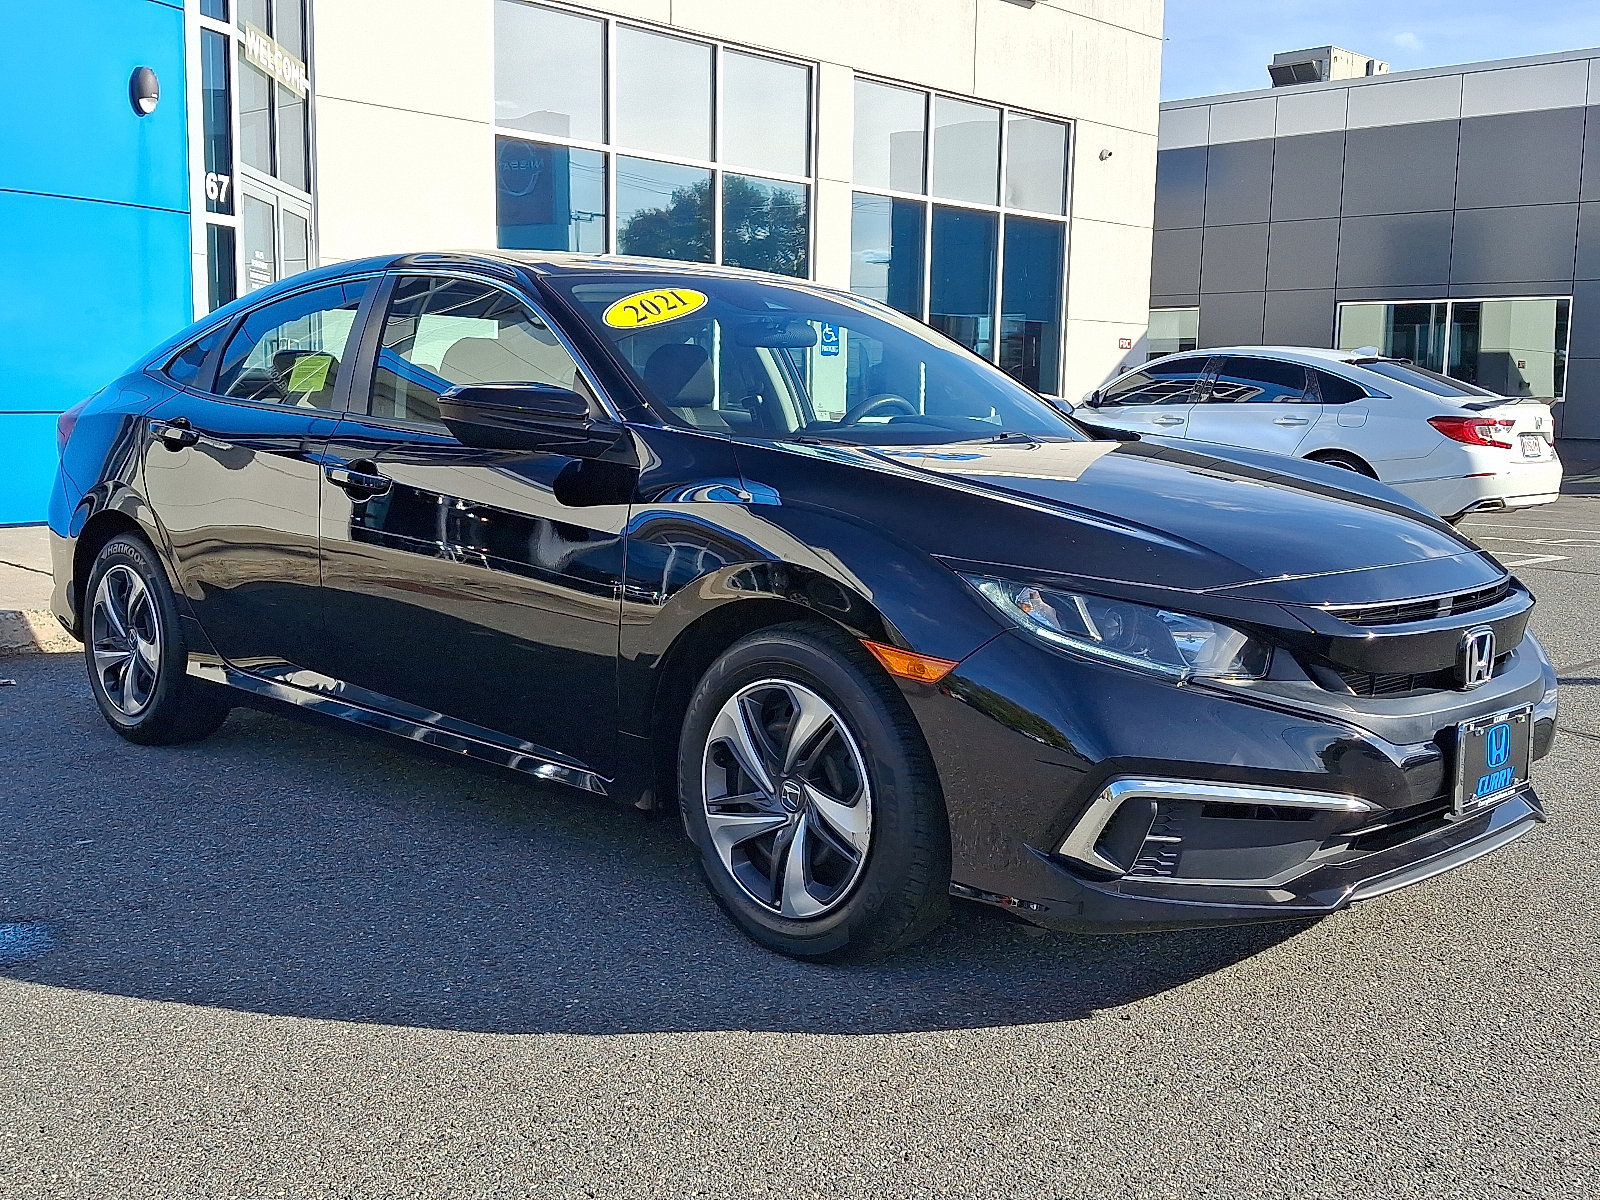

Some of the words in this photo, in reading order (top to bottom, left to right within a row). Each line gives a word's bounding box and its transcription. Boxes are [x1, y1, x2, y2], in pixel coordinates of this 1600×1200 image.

[246, 26, 306, 94] WELCOME
[205, 171, 230, 202] 67
[623, 290, 690, 323] 2021
[1477, 766, 1516, 797] CURRY
